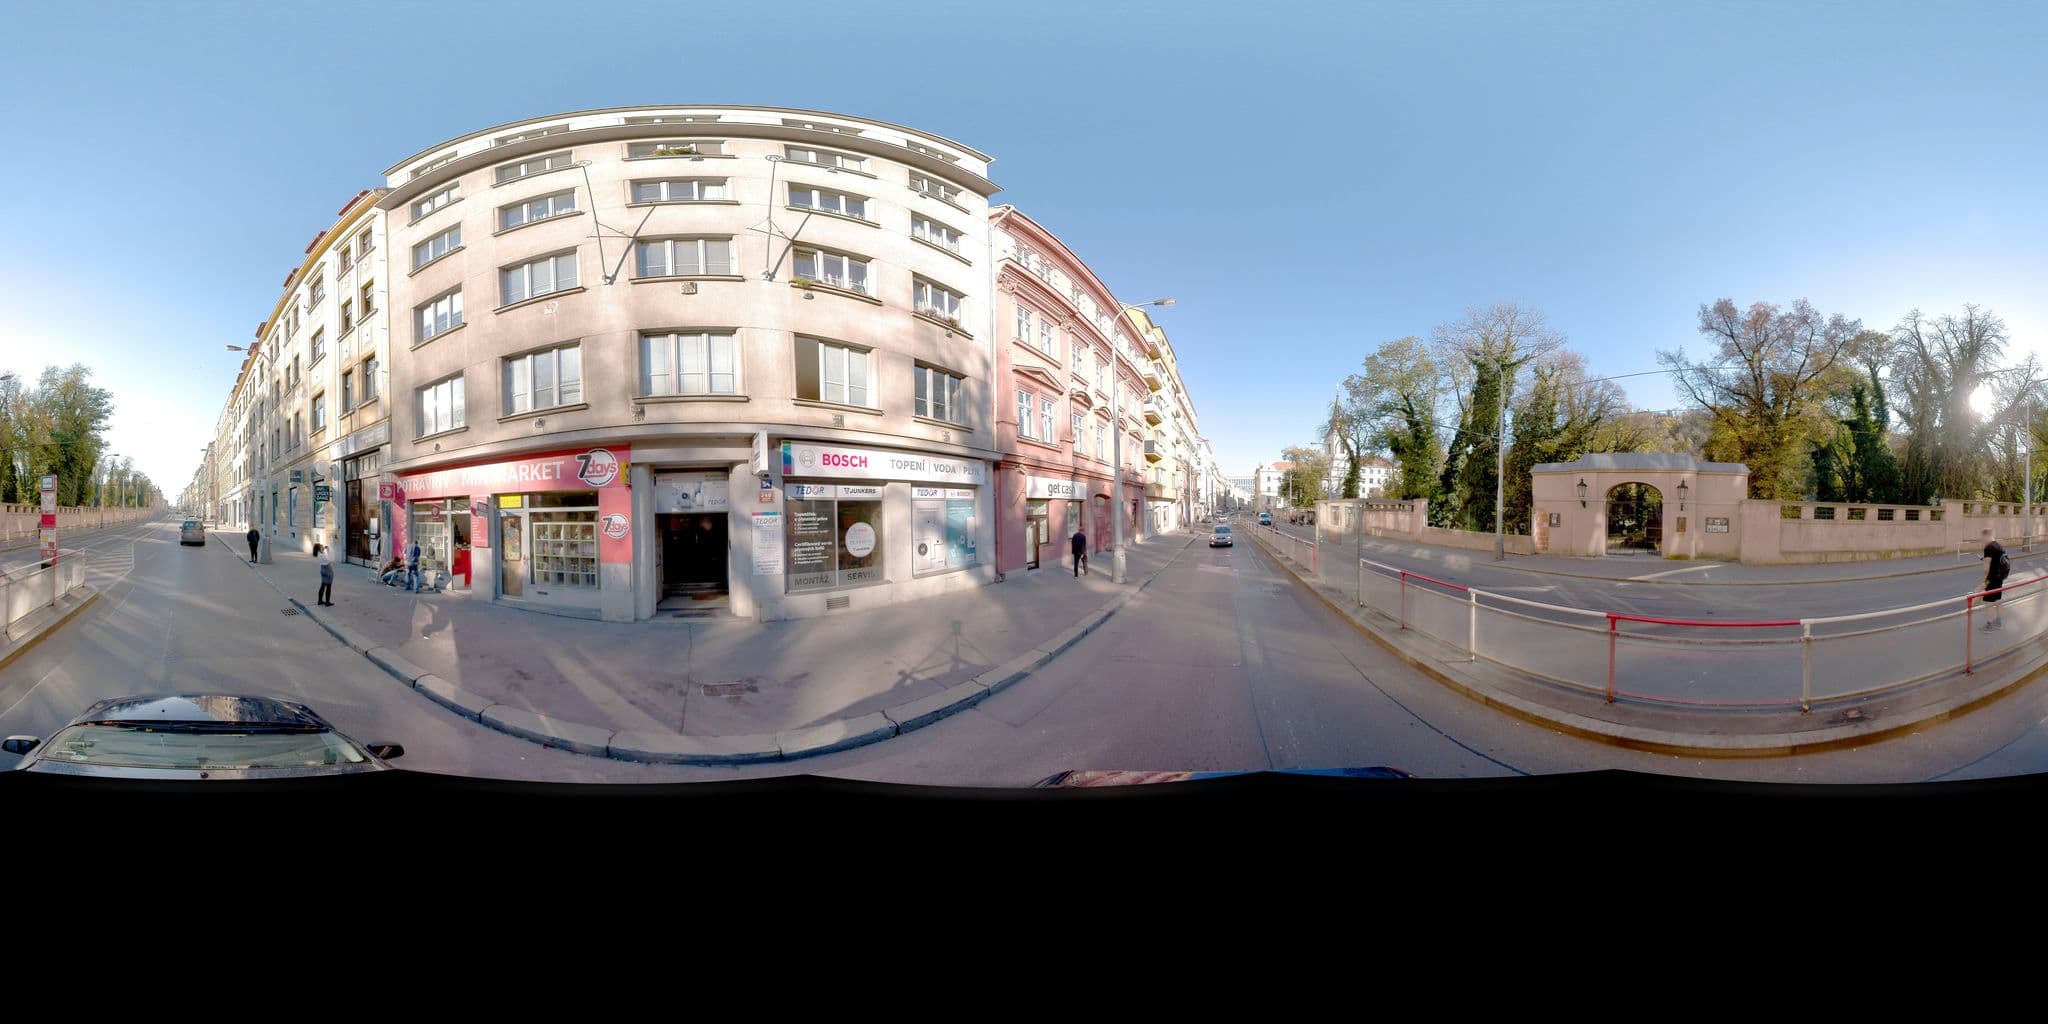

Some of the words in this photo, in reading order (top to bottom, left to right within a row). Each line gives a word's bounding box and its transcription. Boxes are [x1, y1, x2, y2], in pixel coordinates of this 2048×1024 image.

[576, 453, 618, 479] 7days
[822, 453, 868, 468] BOSCH
[890, 458, 925, 472] TOPENÍ
[934, 463, 956, 474] VODA
[396, 470, 449, 492] POTRAVINY
[460, 460, 565, 488] MINIARKET
[850, 487, 876, 495] JUNKERS
[1048, 483, 1060, 496] get
[1062, 484, 1076, 495] cash
[603, 517, 629, 533] 7days
[795, 574, 830, 586] MONTÁŽ
